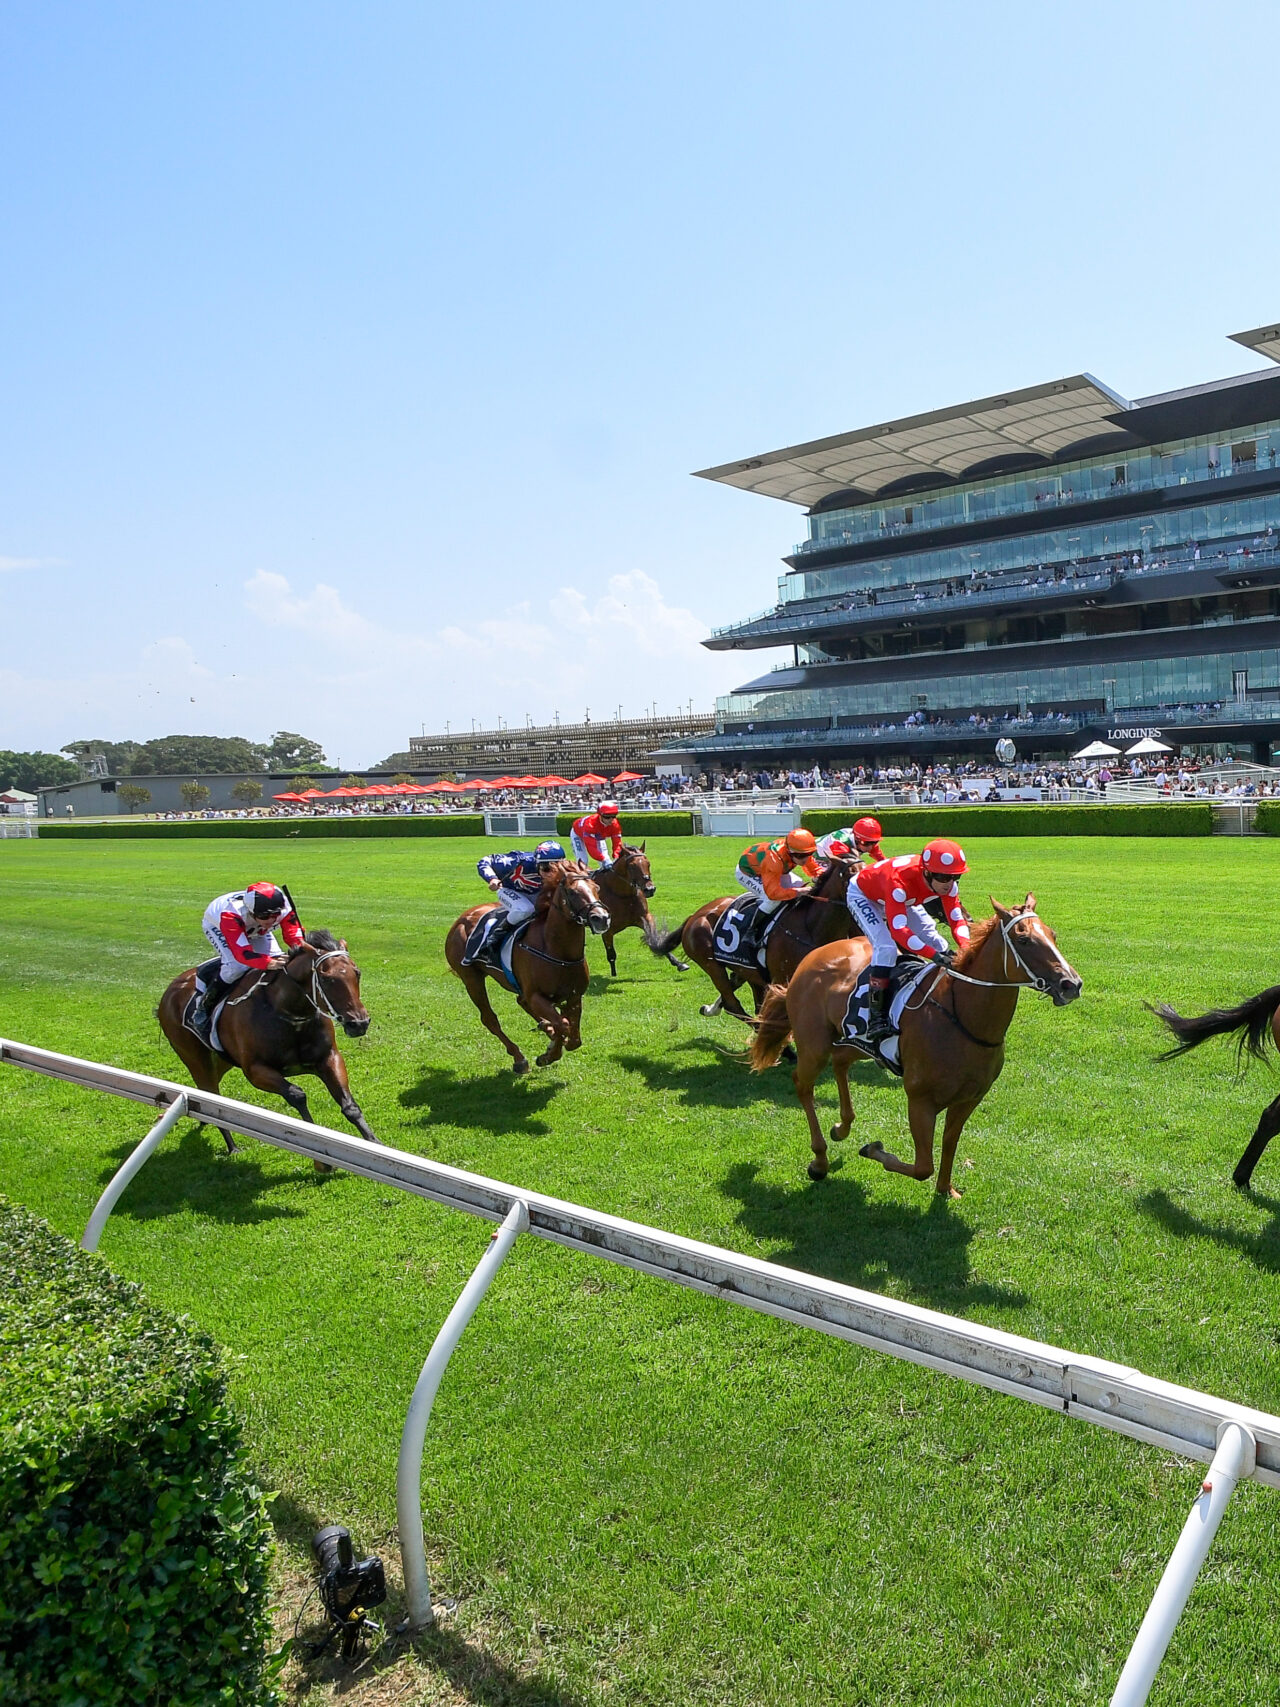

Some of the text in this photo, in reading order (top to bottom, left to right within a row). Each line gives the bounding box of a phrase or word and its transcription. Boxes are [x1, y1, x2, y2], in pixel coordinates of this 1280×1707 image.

[1107, 727, 1162, 739] LONGINES
[746, 879, 762, 894] RYAN
[854, 898, 880, 926] LUCRF
[716, 908, 745, 953] 5
